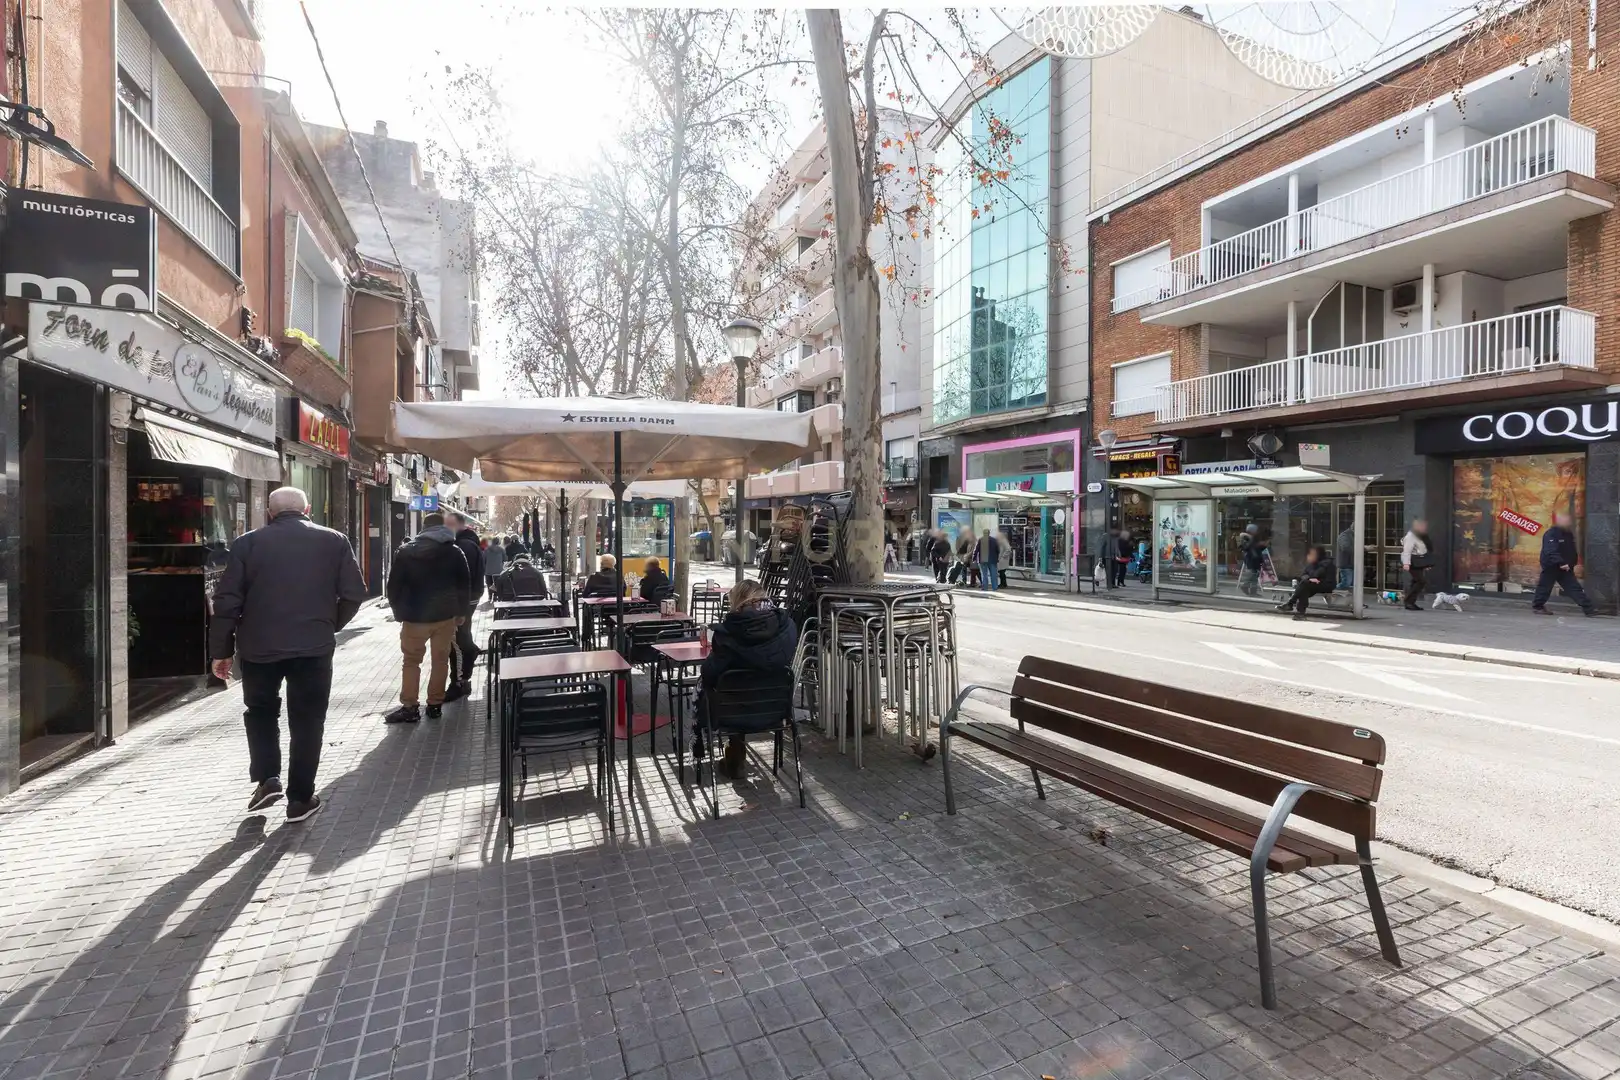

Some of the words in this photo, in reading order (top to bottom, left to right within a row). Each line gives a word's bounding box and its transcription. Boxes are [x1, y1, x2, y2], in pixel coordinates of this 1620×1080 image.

[579, 415, 636, 423] ESTRELLA
[640, 416, 675, 425] DAMM
[1462, 401, 1618, 441] COQU
[1500, 510, 1539, 533] REBAIXES
